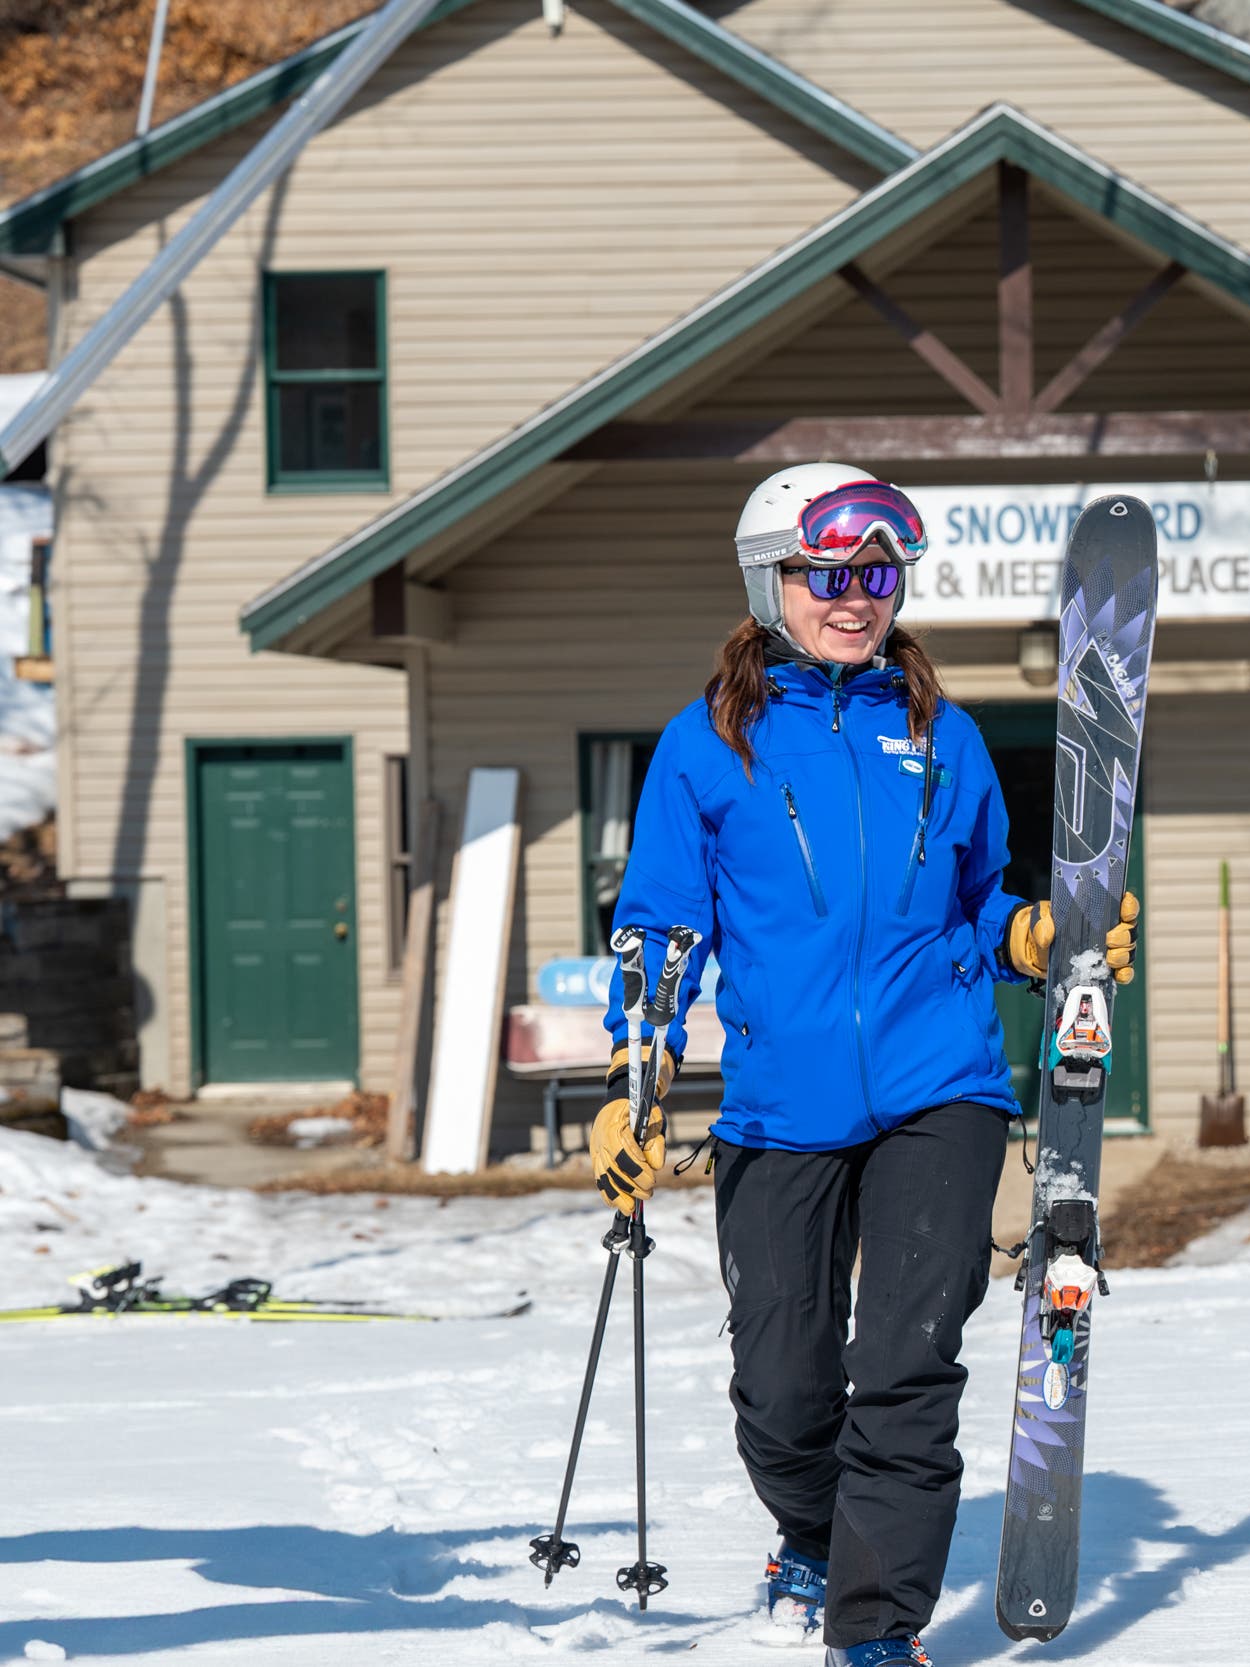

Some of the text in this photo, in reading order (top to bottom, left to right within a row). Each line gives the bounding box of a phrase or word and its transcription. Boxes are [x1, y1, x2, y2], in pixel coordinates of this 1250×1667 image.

[946, 501, 1203, 546] SNOWRD
[754, 548, 787, 562] NATIVE
[935, 560, 965, 599] &
[616, 927, 637, 948] LEKI
[668, 994, 676, 1014] LEKI
